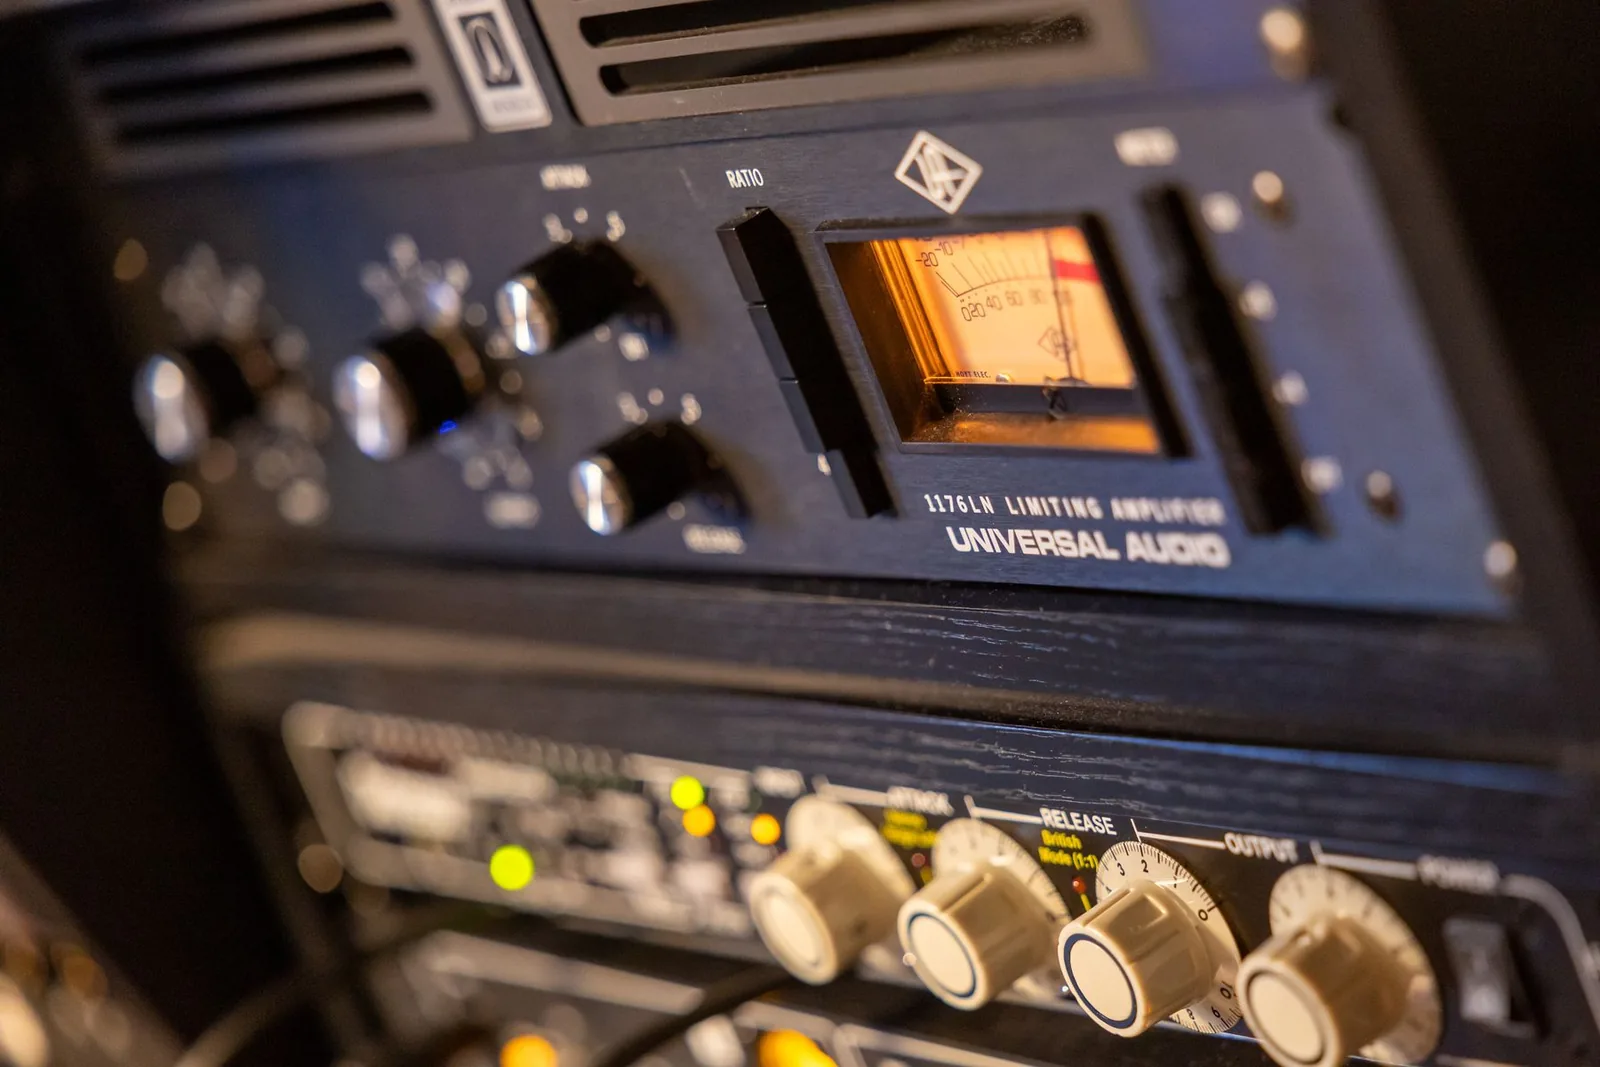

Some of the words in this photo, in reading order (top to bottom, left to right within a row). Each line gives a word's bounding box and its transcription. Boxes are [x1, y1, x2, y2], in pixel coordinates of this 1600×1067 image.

[725, 168, 764, 189] RATIO
[915, 251, 939, 267] -20
[923, 493, 996, 515] 1176LN
[1004, 496, 1104, 520] LIMITING
[945, 526, 1121, 561] UNIVERSAL
[1125, 531, 1232, 569] AUDIO
[1039, 807, 1118, 836] RELEASE
[1041, 829, 1083, 850] British
[1224, 832, 1299, 864] OUTPUT
[1117, 862, 1126, 876] 3
[1140, 859, 1149, 873] 2
